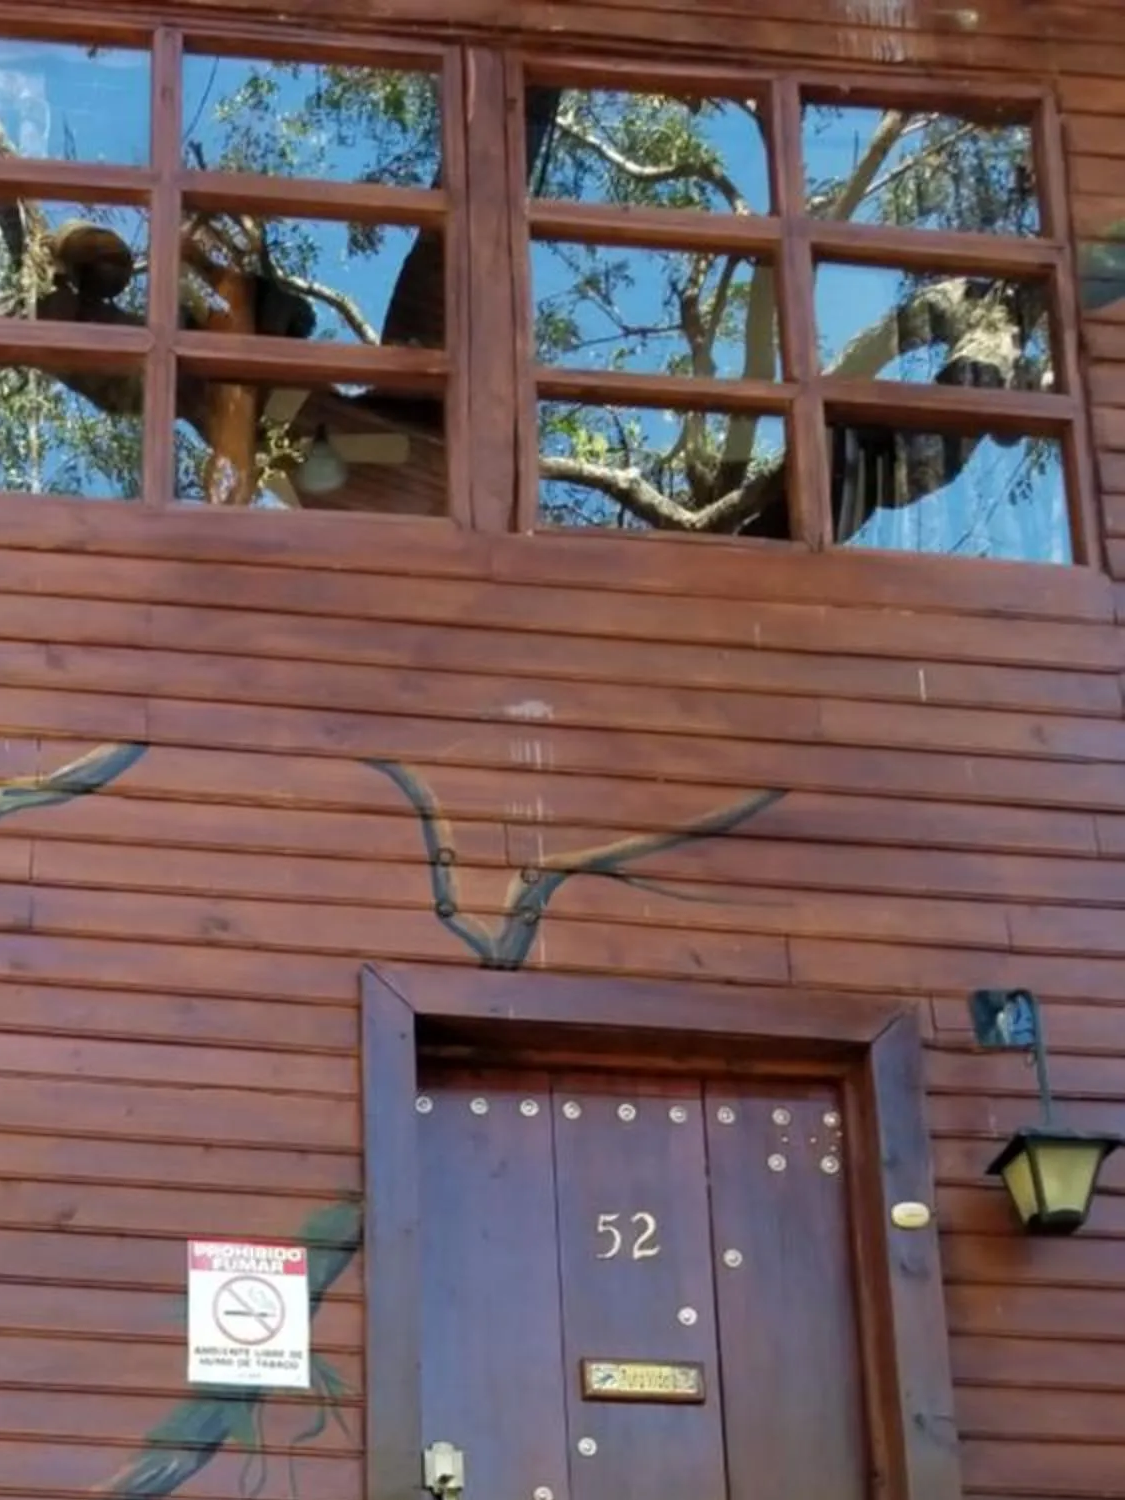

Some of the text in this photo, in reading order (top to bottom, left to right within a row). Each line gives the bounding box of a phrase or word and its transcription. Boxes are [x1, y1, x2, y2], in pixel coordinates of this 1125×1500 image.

[596, 1212, 661, 1259] 52
[193, 1241, 301, 1262] PROHIBIDO
[213, 1258, 283, 1273] FUMAR
